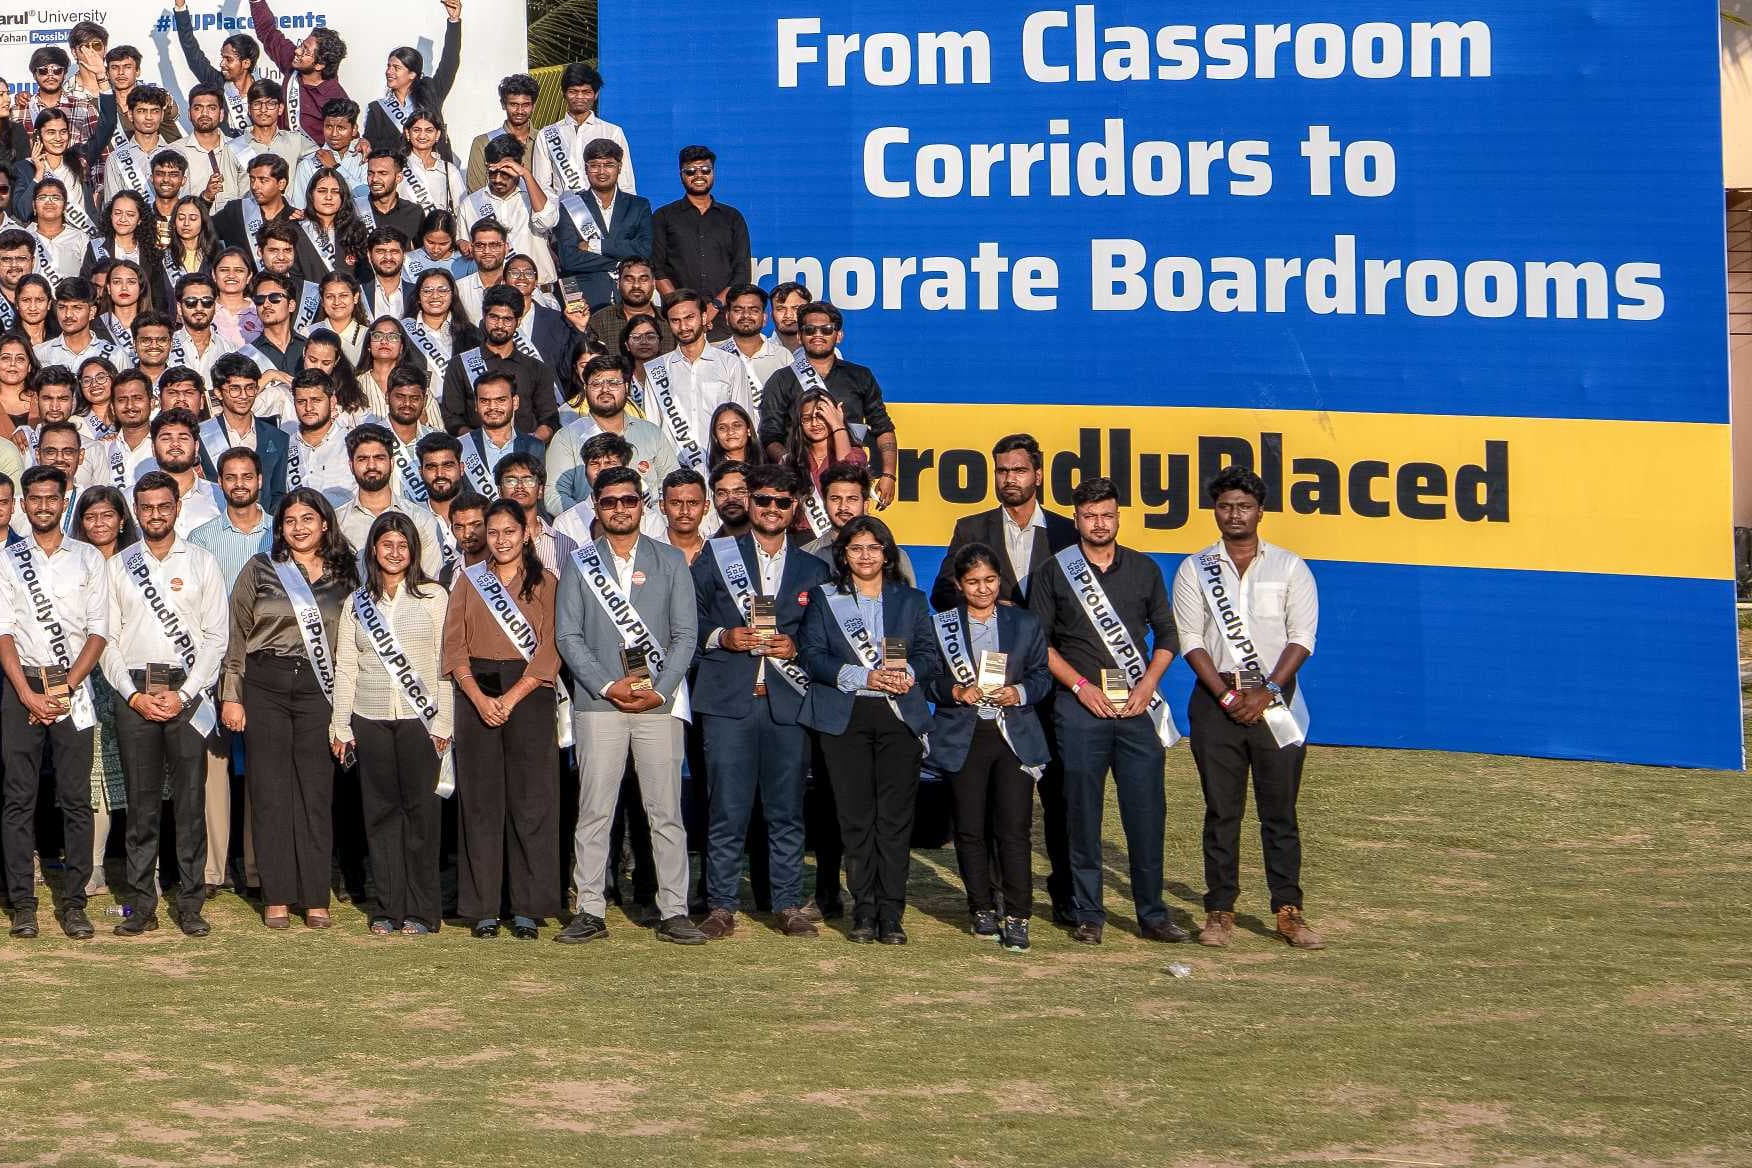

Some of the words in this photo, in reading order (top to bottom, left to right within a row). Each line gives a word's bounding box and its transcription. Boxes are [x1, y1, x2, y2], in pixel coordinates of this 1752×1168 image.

[32, 32, 68, 43] Possibl
[38, 8, 107, 26] University
[777, 17, 991, 88] From
[1022, 4, 1492, 82] Classroom
[862, 118, 1273, 199] Corridors
[1300, 124, 1397, 197] to
[751, 242, 1060, 311] rporate
[1091, 236, 1666, 321] Boardrooms
